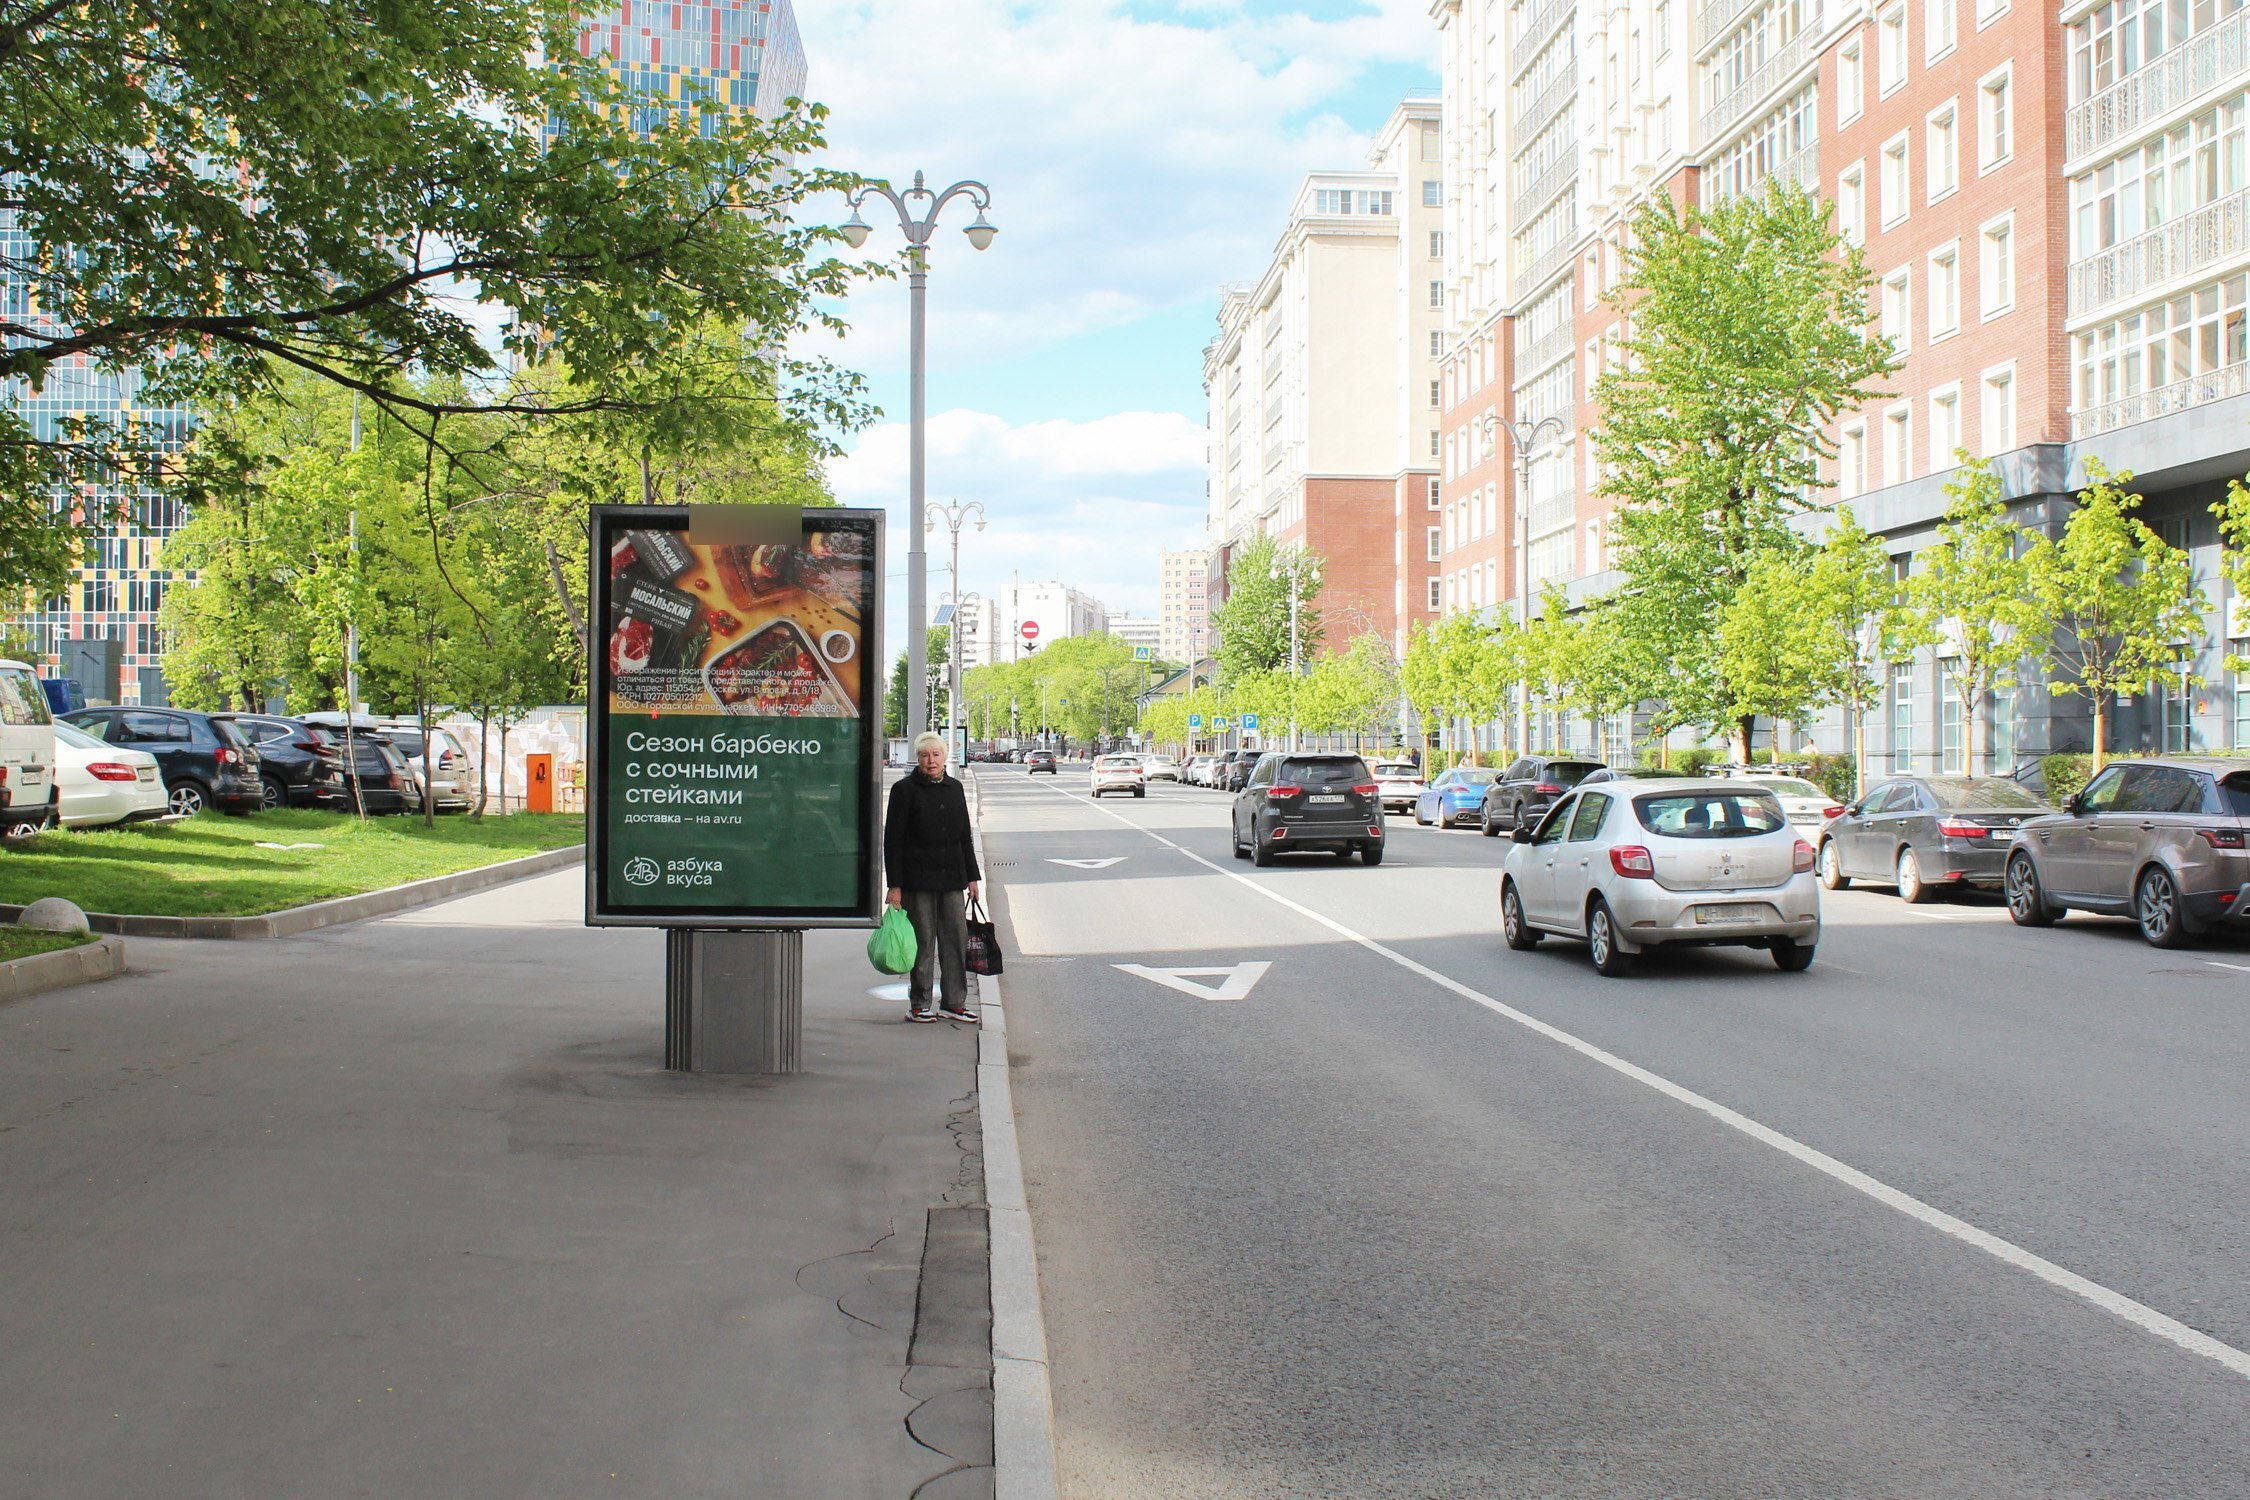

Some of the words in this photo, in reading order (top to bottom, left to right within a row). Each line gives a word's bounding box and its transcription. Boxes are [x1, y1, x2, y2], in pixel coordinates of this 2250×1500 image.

[646, 529, 684, 572] САЛЬСКИЙ
[630, 587, 692, 620] МОСАЛЬСКИЙ
[736, 668, 775, 679] характер
[617, 676, 664, 684] отличаться
[711, 677, 787, 686] представленного
[617, 683, 634, 693] Юр.
[635, 684, 664, 692] адрес:
[617, 693, 641, 701] ОГРН
[617, 701, 639, 709] ООО
[762, 702, 782, 712] ИНН
[1191, 715, 1199, 725] P
[1245, 715, 1254, 728] P
[626, 731, 704, 753] Сезон
[710, 732, 822, 758] барбекю
[626, 762, 641, 778] с
[646, 762, 758, 779] сочными
[625, 783, 743, 804] стейками
[624, 813, 682, 824] доставка
[696, 815, 711, 824] на
[713, 815, 742, 824] av.ru
[667, 857, 723, 874] азбука
[666, 873, 713, 888] вкуса
